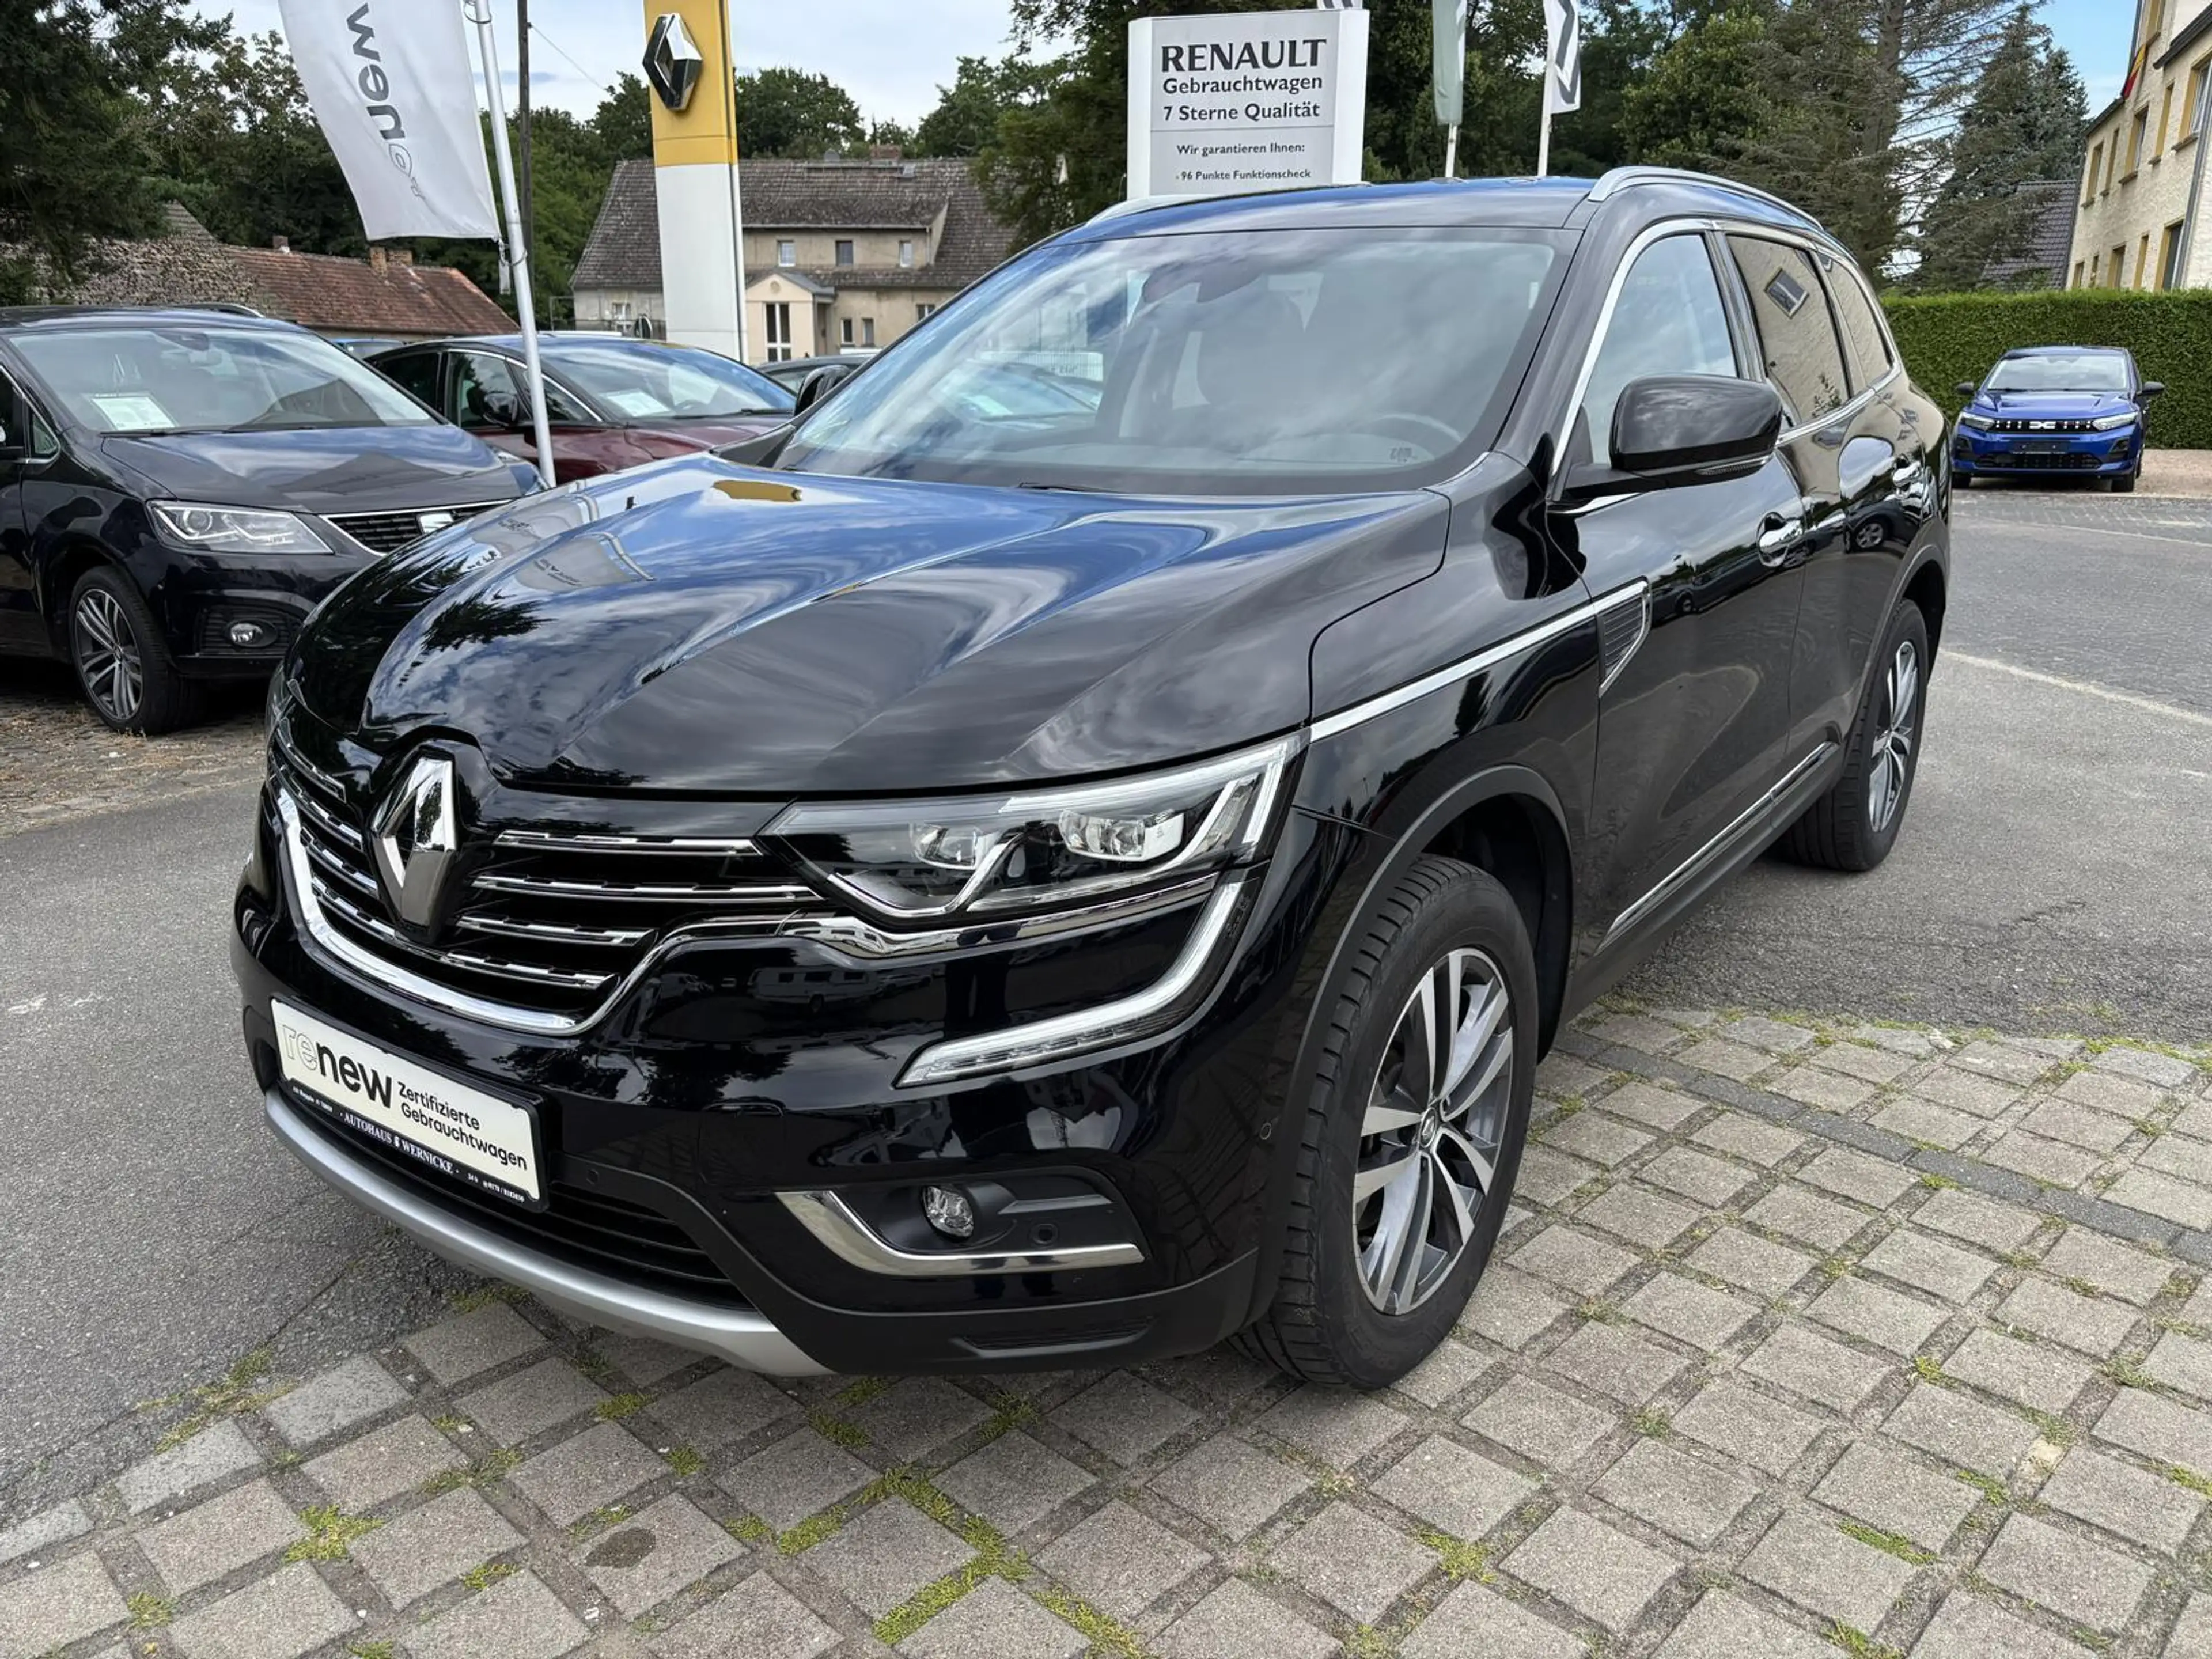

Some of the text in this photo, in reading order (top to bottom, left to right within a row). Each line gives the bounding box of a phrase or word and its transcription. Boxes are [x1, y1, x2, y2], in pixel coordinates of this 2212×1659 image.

[1161, 39, 1327, 73] RENAULT
[1163, 75, 1323, 94] Gebrauchtwagen
[1164, 101, 1320, 122] 7 Sterne Qualität
[1176, 143, 1305, 157] Wir garantieren Ihnen:
[1196, 171, 1231, 180] Punkte
[1233, 169, 1312, 180] Funktionscheck
[282, 1024, 392, 1109] renew
[397, 1081, 480, 1131] Zertifizierte
[344, 1111, 454, 1174] AUTOHAUS WERNICKE
[401, 1102, 527, 1171] Gebrauchtwagen
